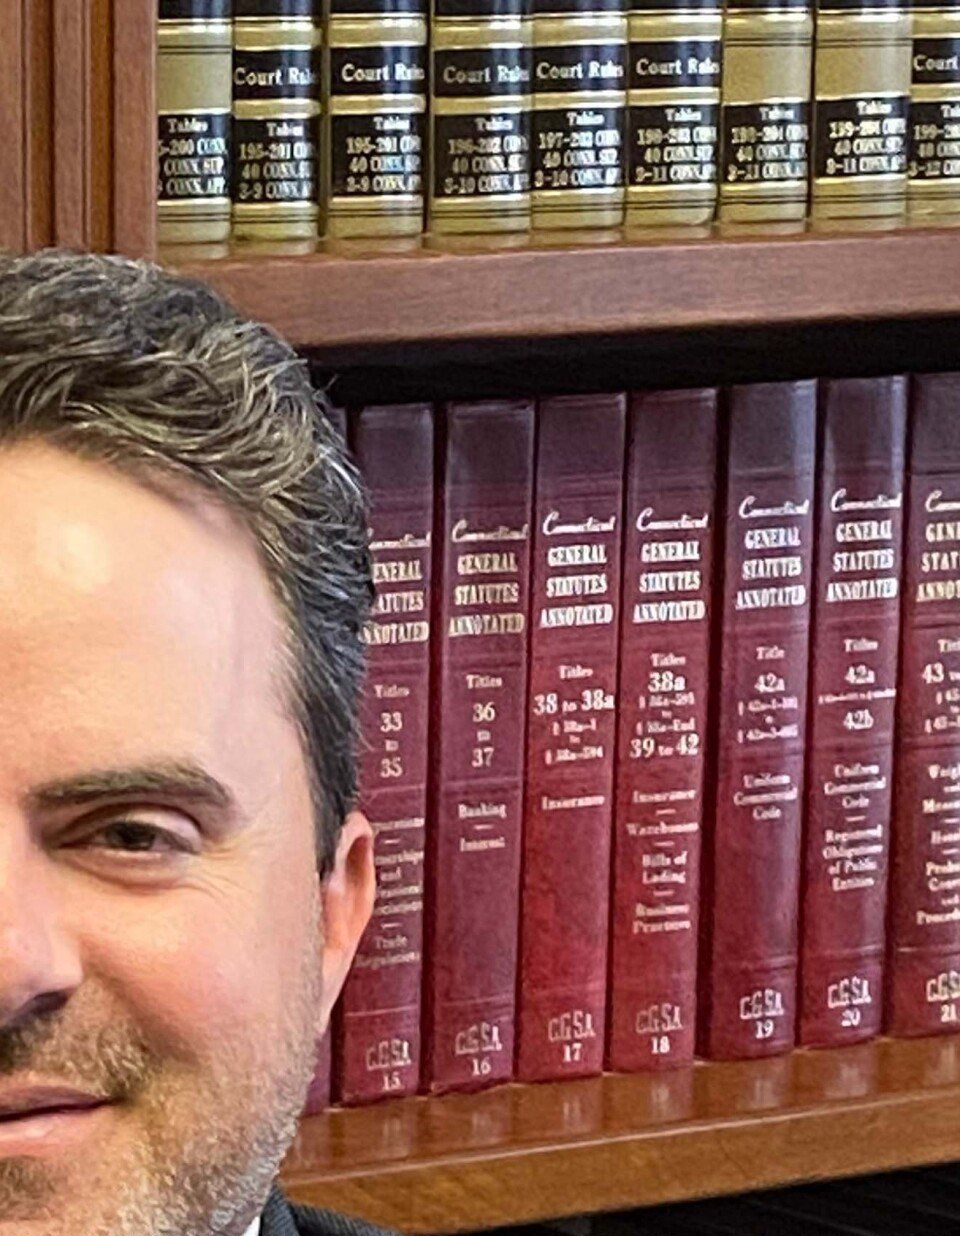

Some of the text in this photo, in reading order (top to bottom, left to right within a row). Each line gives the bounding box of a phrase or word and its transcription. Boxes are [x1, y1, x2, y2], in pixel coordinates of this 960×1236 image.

[342, 64, 388, 82] Court
[536, 61, 623, 79] Court Rules
[636, 57, 720, 76] Court Rules
[914, 55, 959, 71] Court
[234, 67, 282, 86] Court
[443, 67, 490, 83] Court
[744, 527, 801, 550] GENERAL
[835, 520, 893, 543] GENERAL
[547, 544, 607, 567] GENERAL
[641, 540, 700, 563] GENERAL
[833, 549, 894, 573] STATUTES
[457, 552, 518, 575] GENERAL
[742, 556, 802, 580] STATUTES
[546, 573, 608, 598] STATUTES
[639, 570, 701, 593] STATUTES
[826, 577, 899, 603] ANNOTATED
[455, 582, 520, 606] STATUTES
[735, 585, 806, 610] ANNOTATED
[540, 603, 614, 628] ANNOTATED
[632, 600, 706, 624] ANNOTATED
[449, 612, 525, 637] ANNOTATED
[466, 674, 503, 689] Titles
[648, 671, 686, 692] 38a
[922, 662, 944, 684] 43
[472, 702, 495, 723] 36
[533, 693, 558, 716] 38
[562, 700, 577, 713] to
[581, 689, 615, 711] 38a
[380, 712, 403, 732] 33
[629, 738, 654, 758] 39
[676, 733, 700, 755] 42
[380, 757, 403, 778] 35
[471, 747, 494, 768] 37
[458, 803, 507, 819] Banking
[753, 806, 782, 820] Code
[827, 975, 871, 1009] CGSA
[740, 988, 785, 1020] CGSA
[941, 1004, 957, 1023] 21
[548, 1009, 597, 1043] CGSA
[635, 1002, 685, 1034] CGSA
[755, 1020, 774, 1039] 19
[841, 1008, 862, 1028] 20
[455, 1022, 502, 1056] CGSA
[650, 1035, 670, 1054] 18
[366, 1038, 411, 1072] CGSA
[563, 1042, 582, 1063] 17
[472, 1057, 491, 1077] 16
[382, 1072, 402, 1091] 15
